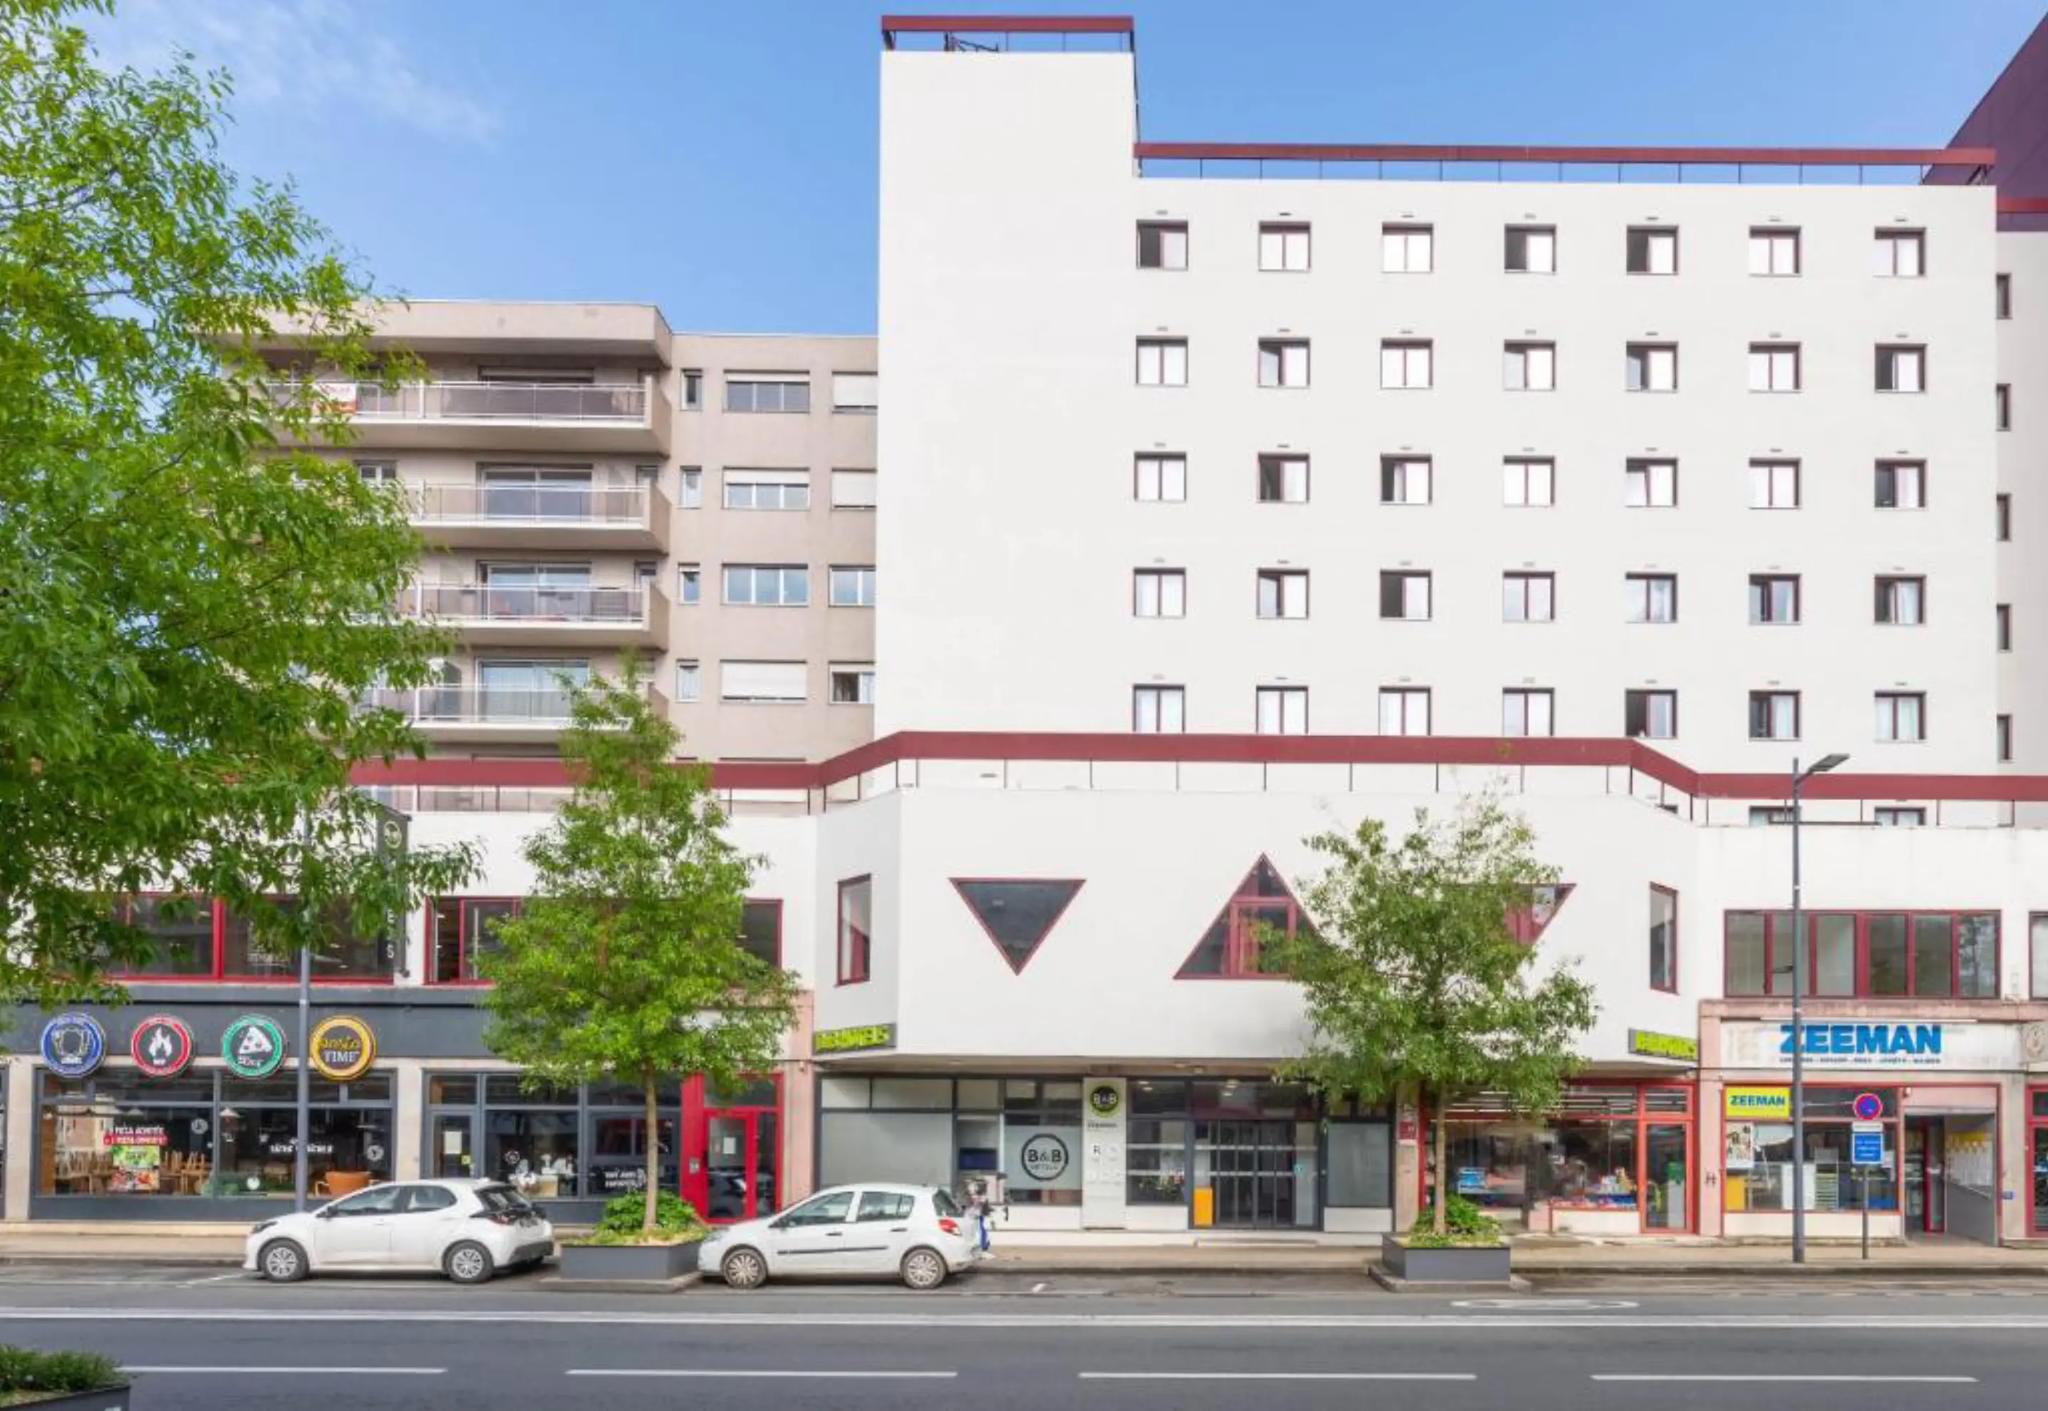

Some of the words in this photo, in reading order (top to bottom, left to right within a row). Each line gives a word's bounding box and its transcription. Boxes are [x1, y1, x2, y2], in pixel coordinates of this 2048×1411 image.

[1780, 1025, 1941, 1054] ZEEMAN
[324, 1051, 360, 1063] TIME
[1730, 1095, 1785, 1106] ZEEMAN
[1027, 1148, 1062, 1163] B&B
